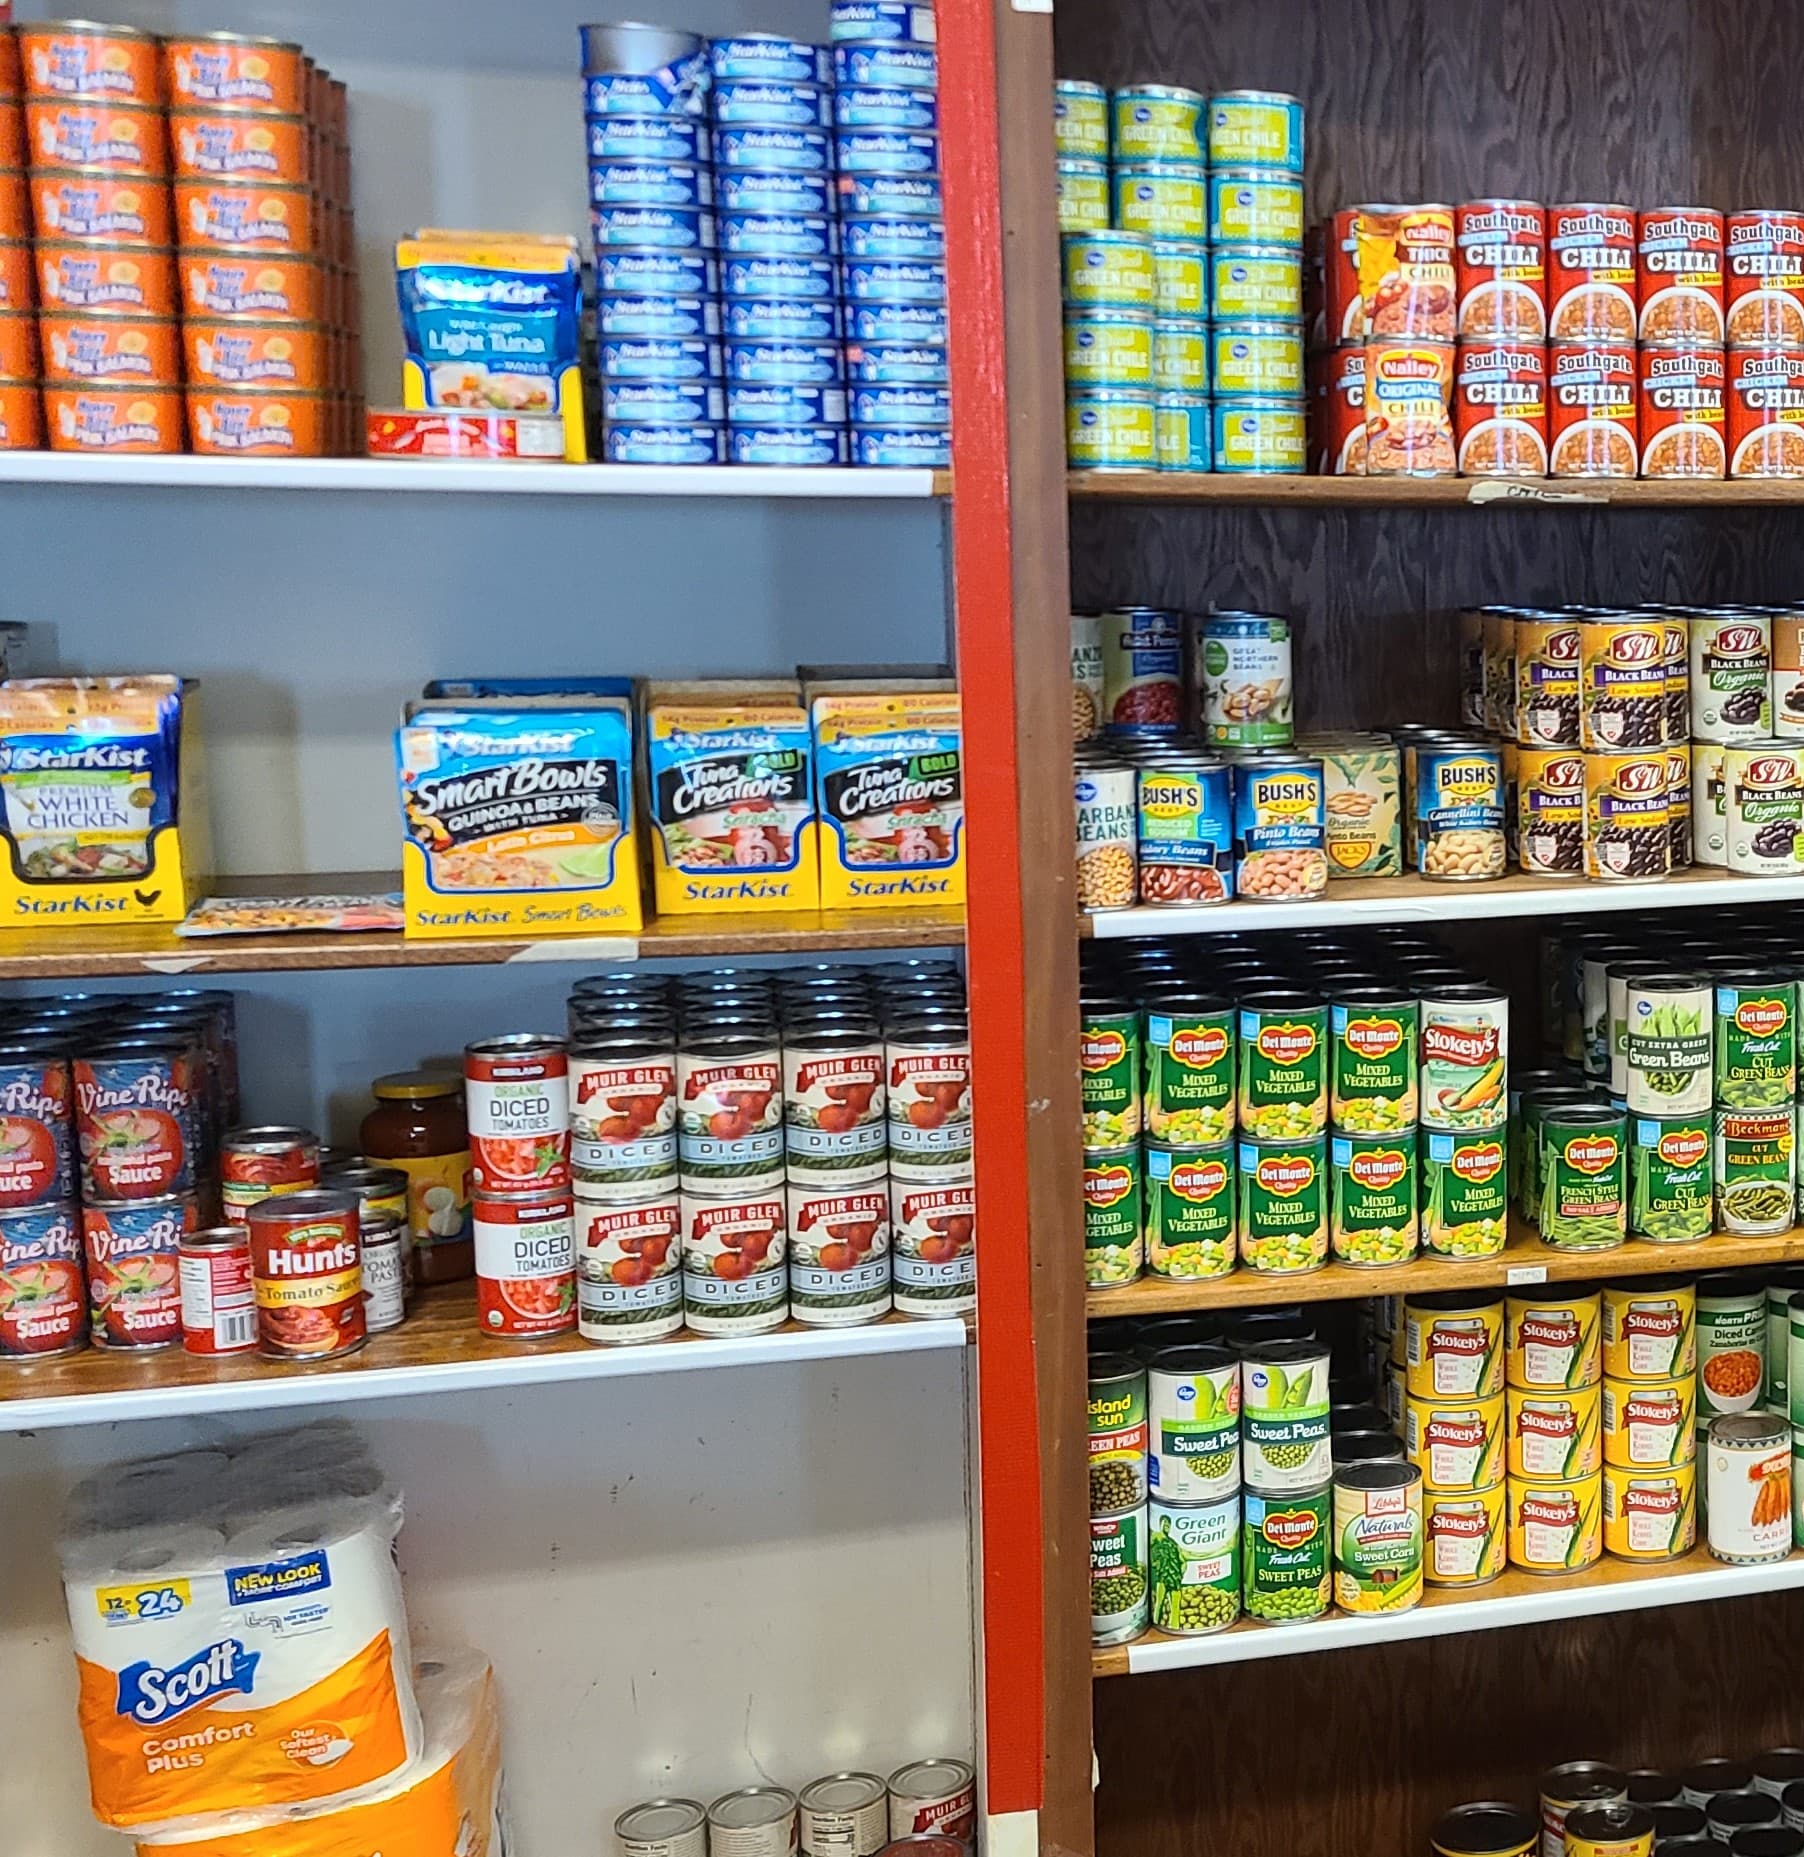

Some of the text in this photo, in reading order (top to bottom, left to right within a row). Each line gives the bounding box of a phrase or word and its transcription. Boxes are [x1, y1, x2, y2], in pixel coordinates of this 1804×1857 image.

[1465, 213, 1541, 233] Southgate
[1466, 245, 1538, 266] CHILI
[429, 330, 547, 355] Light Tuna
[1384, 363, 1438, 378] Nalley
[1380, 382, 1441, 398] ORIGINAL
[1388, 401, 1434, 415] CHILI
[1711, 657, 1767, 669] BLACK BEANS
[1709, 669, 1766, 690] Organic
[463, 733, 574, 754] StarKist
[18, 745, 152, 770] StarKist
[921, 751, 958, 773] BOLD
[686, 763, 741, 791] Tuna
[1441, 764, 1496, 786] BUSH'S
[417, 759, 608, 815] Smart Bowls
[671, 776, 793, 813] Creations
[1143, 784, 1198, 807] BUSH'S
[1258, 782, 1316, 803] BUSH'S
[41, 796, 118, 812] WHITE
[27, 812, 129, 828] CHICKEN
[1253, 825, 1319, 840] Pinto Beans
[847, 876, 951, 896] StarKist
[16, 896, 129, 914] StarKist
[414, 909, 511, 926] StarKist
[1349, 1028, 1399, 1043] Del Monte
[1425, 1029, 1496, 1056] Stokely's
[1629, 1049, 1710, 1067] Green Beans
[585, 1070, 627, 1087] MUIR
[1356, 1064, 1391, 1076] MIXED
[1344, 1074, 1403, 1088] VEGETABLES
[77, 1083, 135, 1114] Vine
[490, 1097, 550, 1117] DICED
[492, 1116, 550, 1130] TOMATOES
[590, 1141, 672, 1160] DICED
[109, 1165, 162, 1184] Sauce
[269, 1243, 356, 1275] Hunt's
[265, 1288, 323, 1300] Tomato
[16, 1315, 71, 1338] Sauce
[1432, 1334, 1486, 1352] Stokely's
[1097, 1411, 1124, 1426] sun
[1251, 1421, 1324, 1439] Sweet Peas
[1175, 1514, 1225, 1532] Green
[1357, 1515, 1414, 1536] Naturals
[1181, 1527, 1227, 1546] Giant
[1355, 1546, 1414, 1562] Sweet Corn
[234, 1562, 321, 1592] NEW LOOK
[1259, 1566, 1322, 1582] SWEET PEAS
[106, 1589, 181, 1616] 12 24
[136, 1639, 237, 1720] Scott
[141, 1722, 256, 1756] Comfort
[279, 1735, 330, 1750] Softest
[290, 1728, 316, 1739] Our
[286, 1746, 328, 1759] Clean
[145, 1752, 204, 1774] Plus
